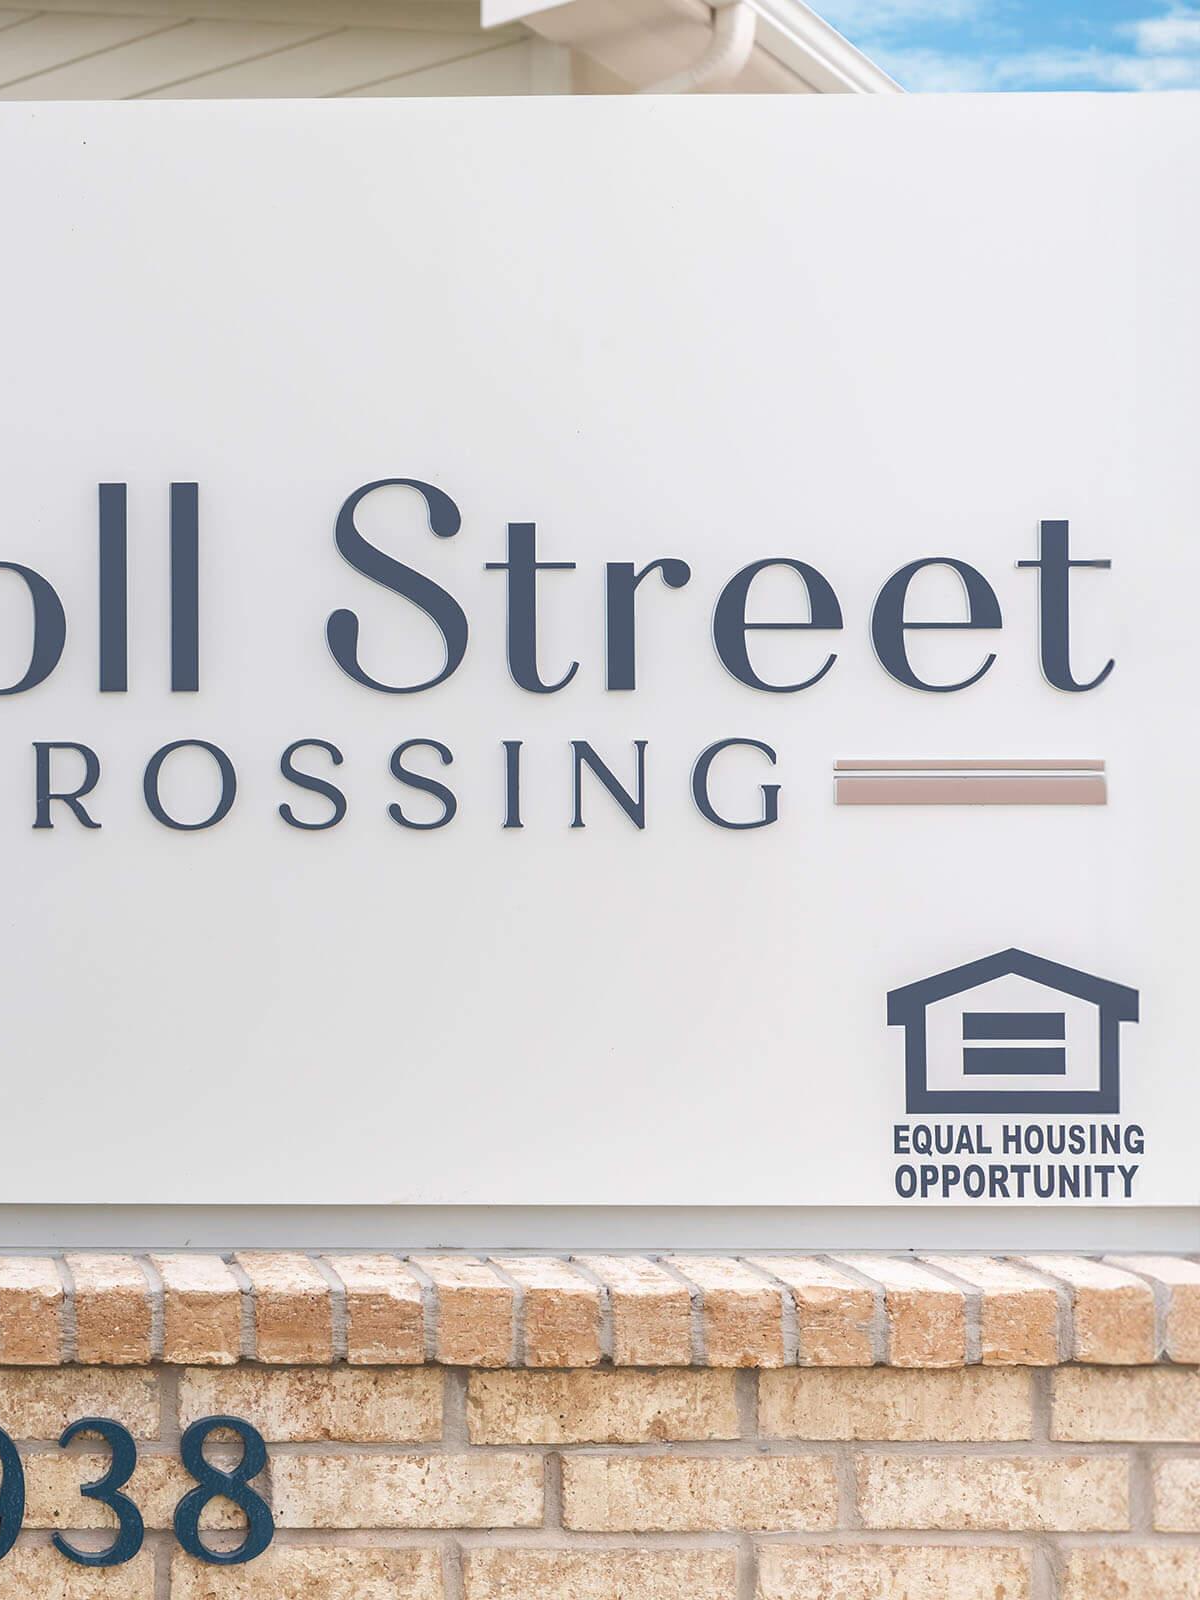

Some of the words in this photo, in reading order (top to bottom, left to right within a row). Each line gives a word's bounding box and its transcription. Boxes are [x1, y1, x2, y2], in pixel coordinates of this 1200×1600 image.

[326, 478, 1116, 696] Street
[893, 1124, 994, 1157] EQUAL
[1002, 1124, 1146, 1155] HOUSING
[894, 1164, 1139, 1199] OPPORTUNITY
